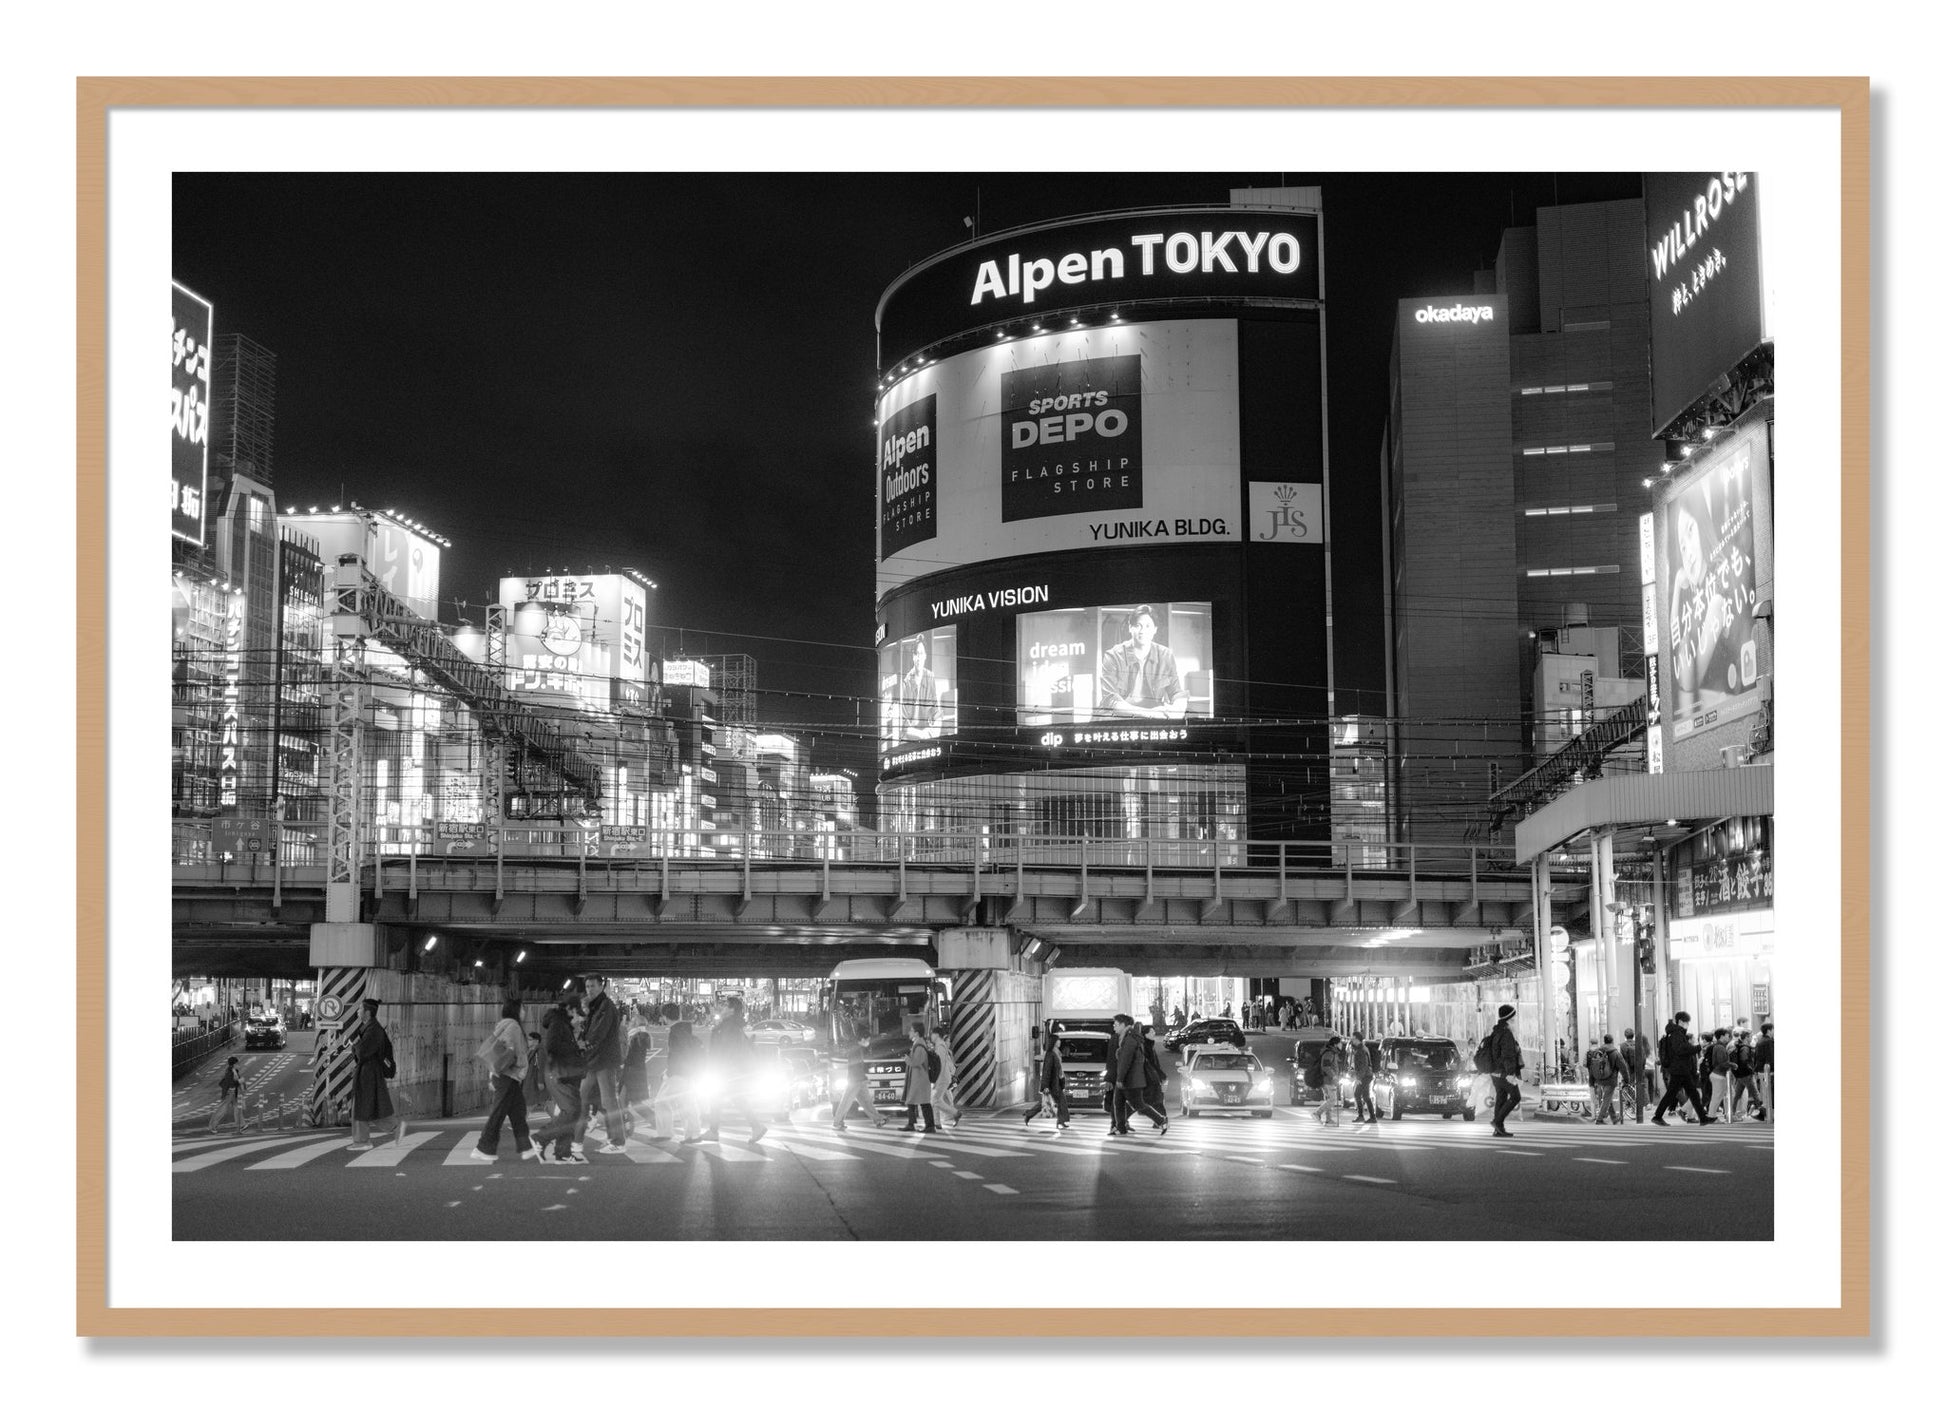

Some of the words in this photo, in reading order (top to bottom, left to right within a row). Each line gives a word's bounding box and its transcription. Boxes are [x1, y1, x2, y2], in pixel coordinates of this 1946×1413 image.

[1652, 172, 1748, 282] WILLROSE
[970, 246, 1124, 306] Alpen
[1131, 231, 1301, 276] TOKYO
[1415, 303, 1493, 325] okadaya
[1028, 390, 1109, 415] SPORTS
[1011, 409, 1129, 450] DEPO
[883, 425, 930, 471] Alpen
[1011, 458, 1130, 482] FLAGSHIP
[886, 462, 929, 503] Outdoors
[1054, 475, 1130, 494] STORE
[883, 491, 930, 524] FLAGSHIP
[896, 508, 930, 531] STORE
[1089, 520, 1169, 541] YUNIKA
[1174, 518, 1230, 538] BLDG.
[289, 585, 319, 606] SHISHA
[525, 580, 596, 599] プロミス
[931, 593, 986, 620] YUNIKA
[988, 584, 1050, 608] VISION
[1030, 641, 1085, 659] dream
[1041, 732, 1063, 748] dip
[1074, 729, 1188, 743] 夢を叶える仕事に出会おう
